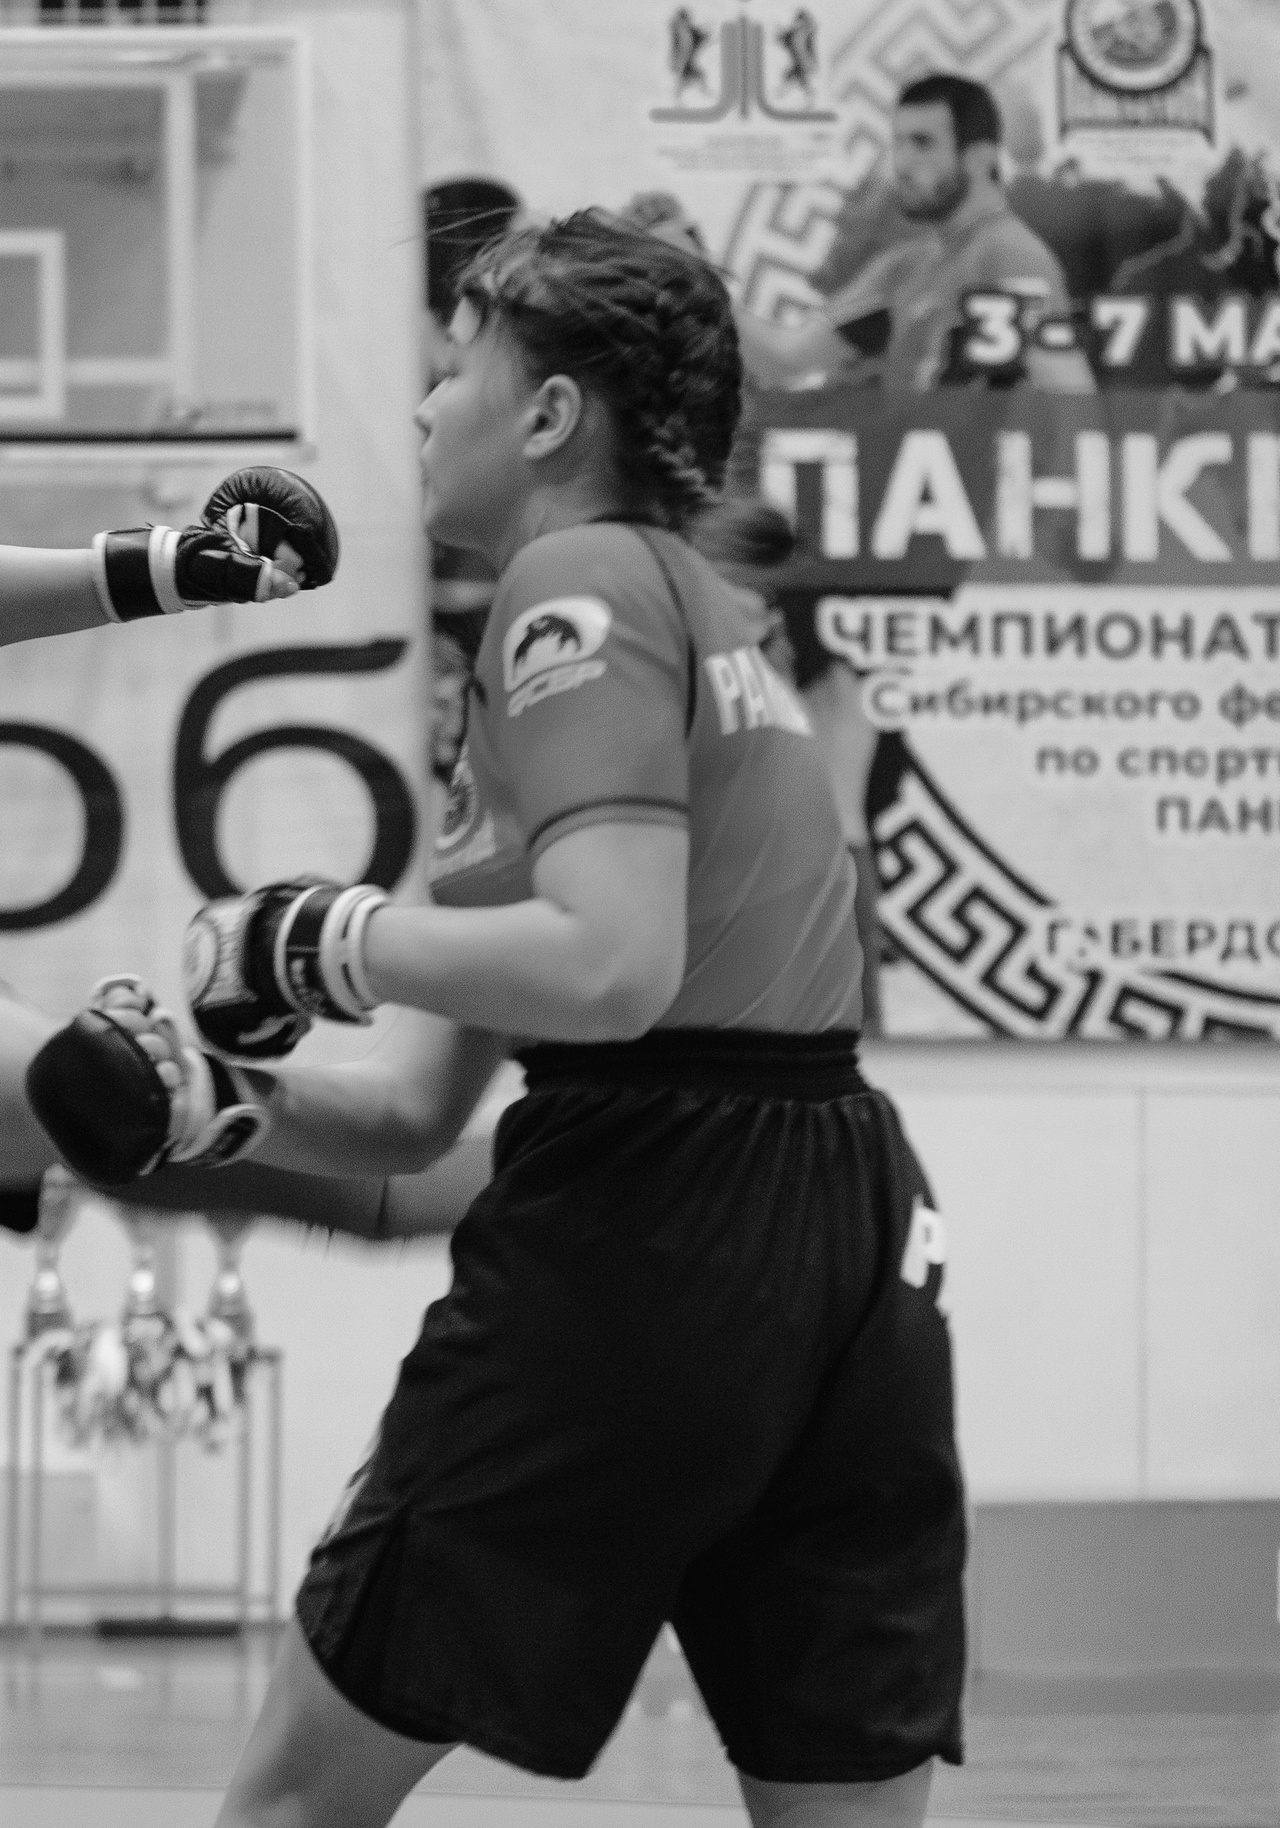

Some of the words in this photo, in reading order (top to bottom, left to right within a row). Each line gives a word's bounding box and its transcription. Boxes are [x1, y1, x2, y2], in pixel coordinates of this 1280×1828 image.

[966, 298, 1022, 366] 3
[1093, 298, 1148, 366] 7
[830, 610, 1280, 662] ЧЕМПИОНАТ
[869, 677, 1202, 729] Сибирского
[1035, 745, 1102, 779] по
[1117, 744, 1280, 788] спорт
[1155, 795, 1280, 836] ПАН
